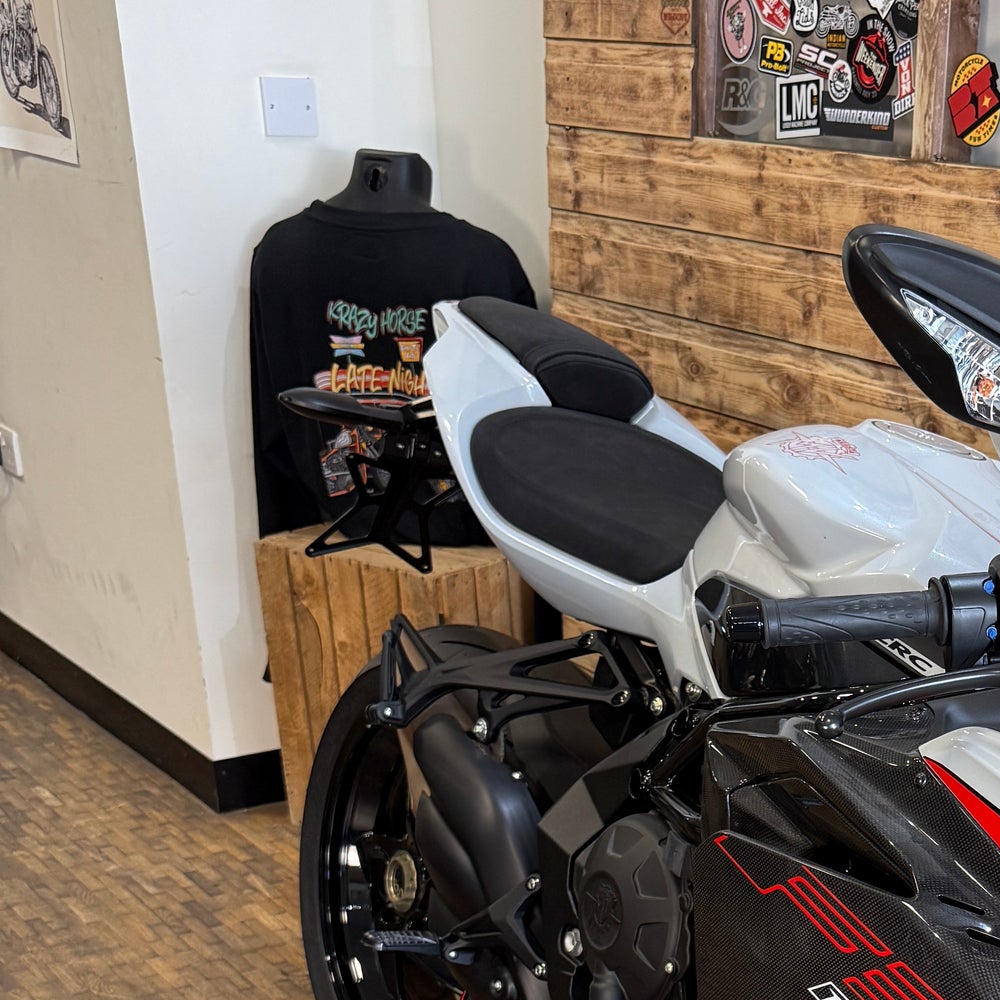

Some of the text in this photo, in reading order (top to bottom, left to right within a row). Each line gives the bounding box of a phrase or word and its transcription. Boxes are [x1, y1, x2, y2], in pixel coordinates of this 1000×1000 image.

[766, 41, 785, 62] PB
[883, 26, 895, 52] SHOW
[760, 60, 788, 73] Pro-Bolt
[798, 43, 838, 69] SC
[899, 57, 911, 97] VON
[953, 57, 985, 88] MOTORCYCLE
[781, 82, 819, 122] LMC
[894, 95, 915, 116] DIR
[380, 306, 429, 337] HORSE
[329, 362, 386, 394] LATE
